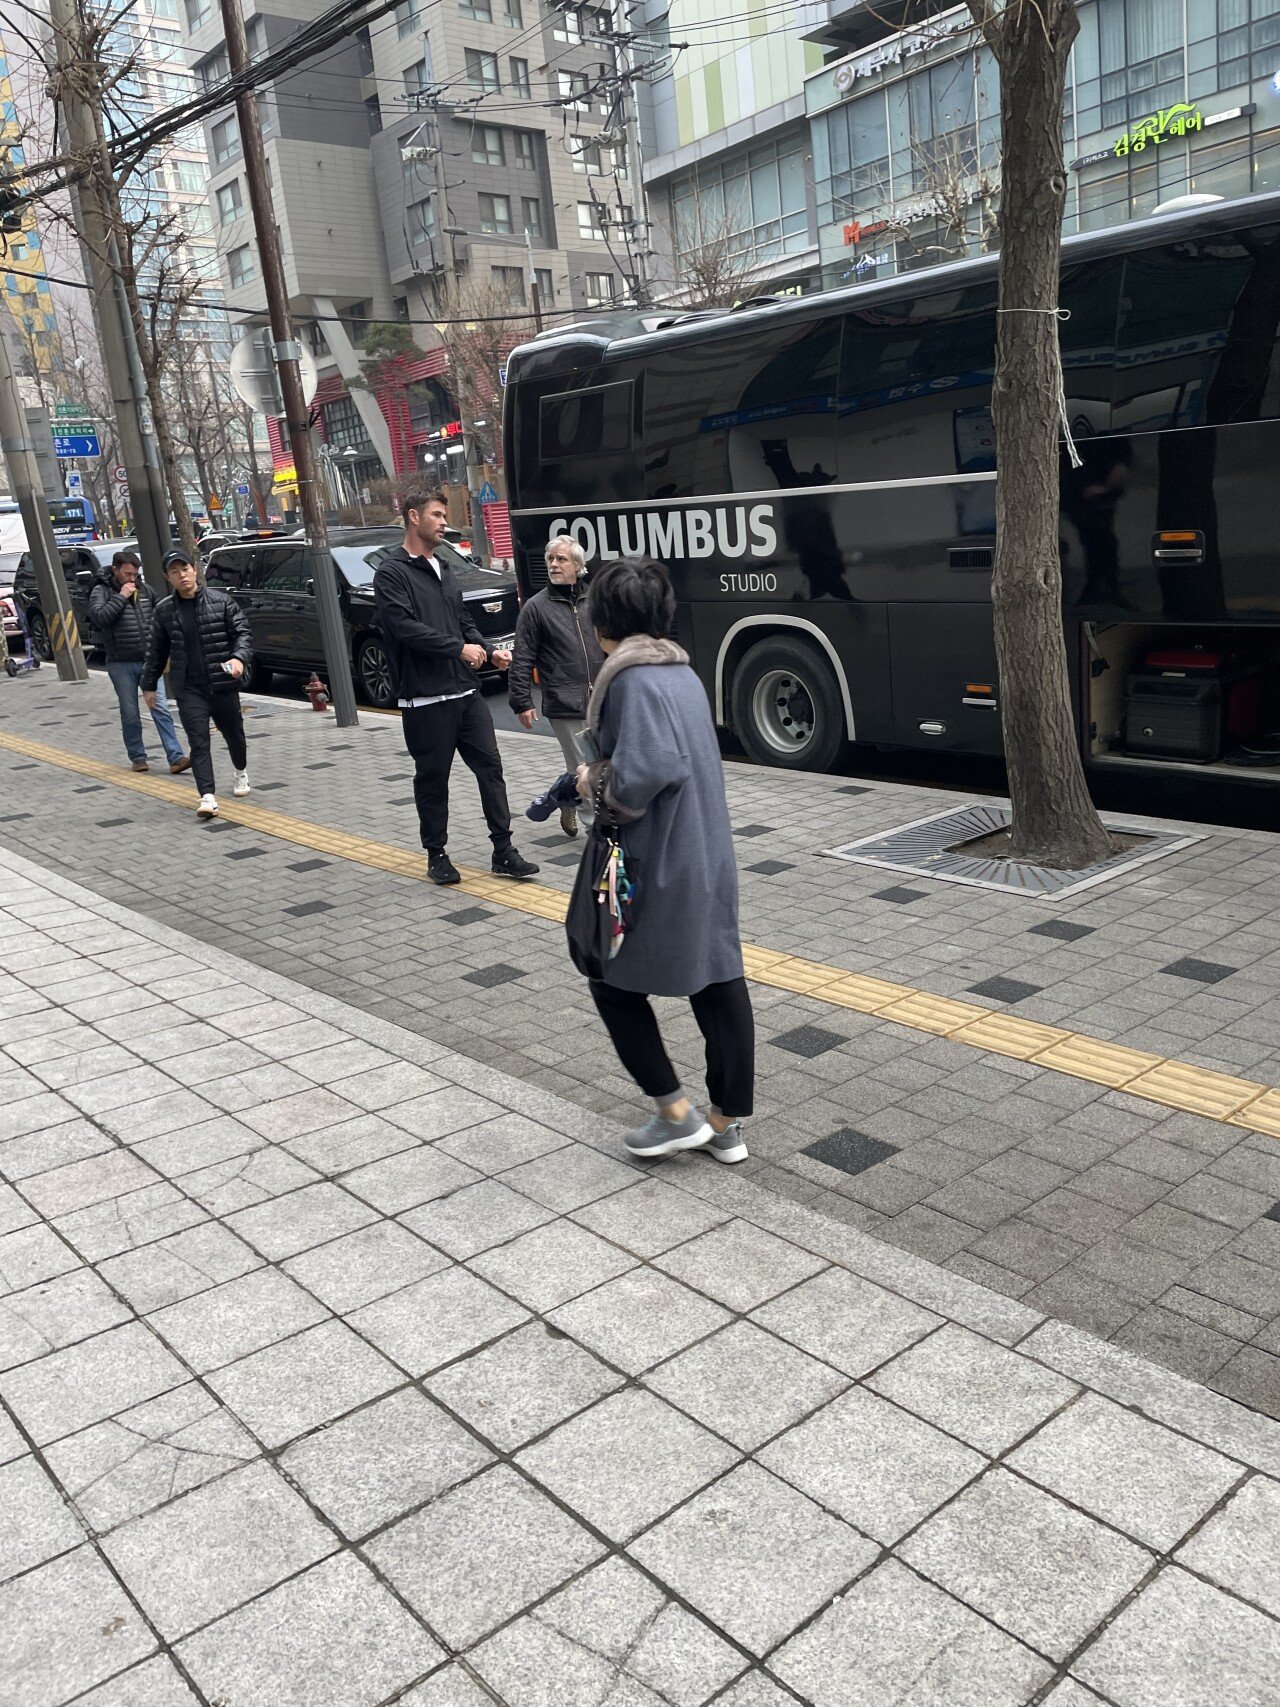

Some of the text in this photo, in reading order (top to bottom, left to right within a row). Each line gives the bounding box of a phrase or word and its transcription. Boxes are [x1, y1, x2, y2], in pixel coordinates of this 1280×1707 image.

[54, 438, 71, 448] 촌로
[67, 509, 80, 518] 171
[720, 573, 777, 592] STUDIO
